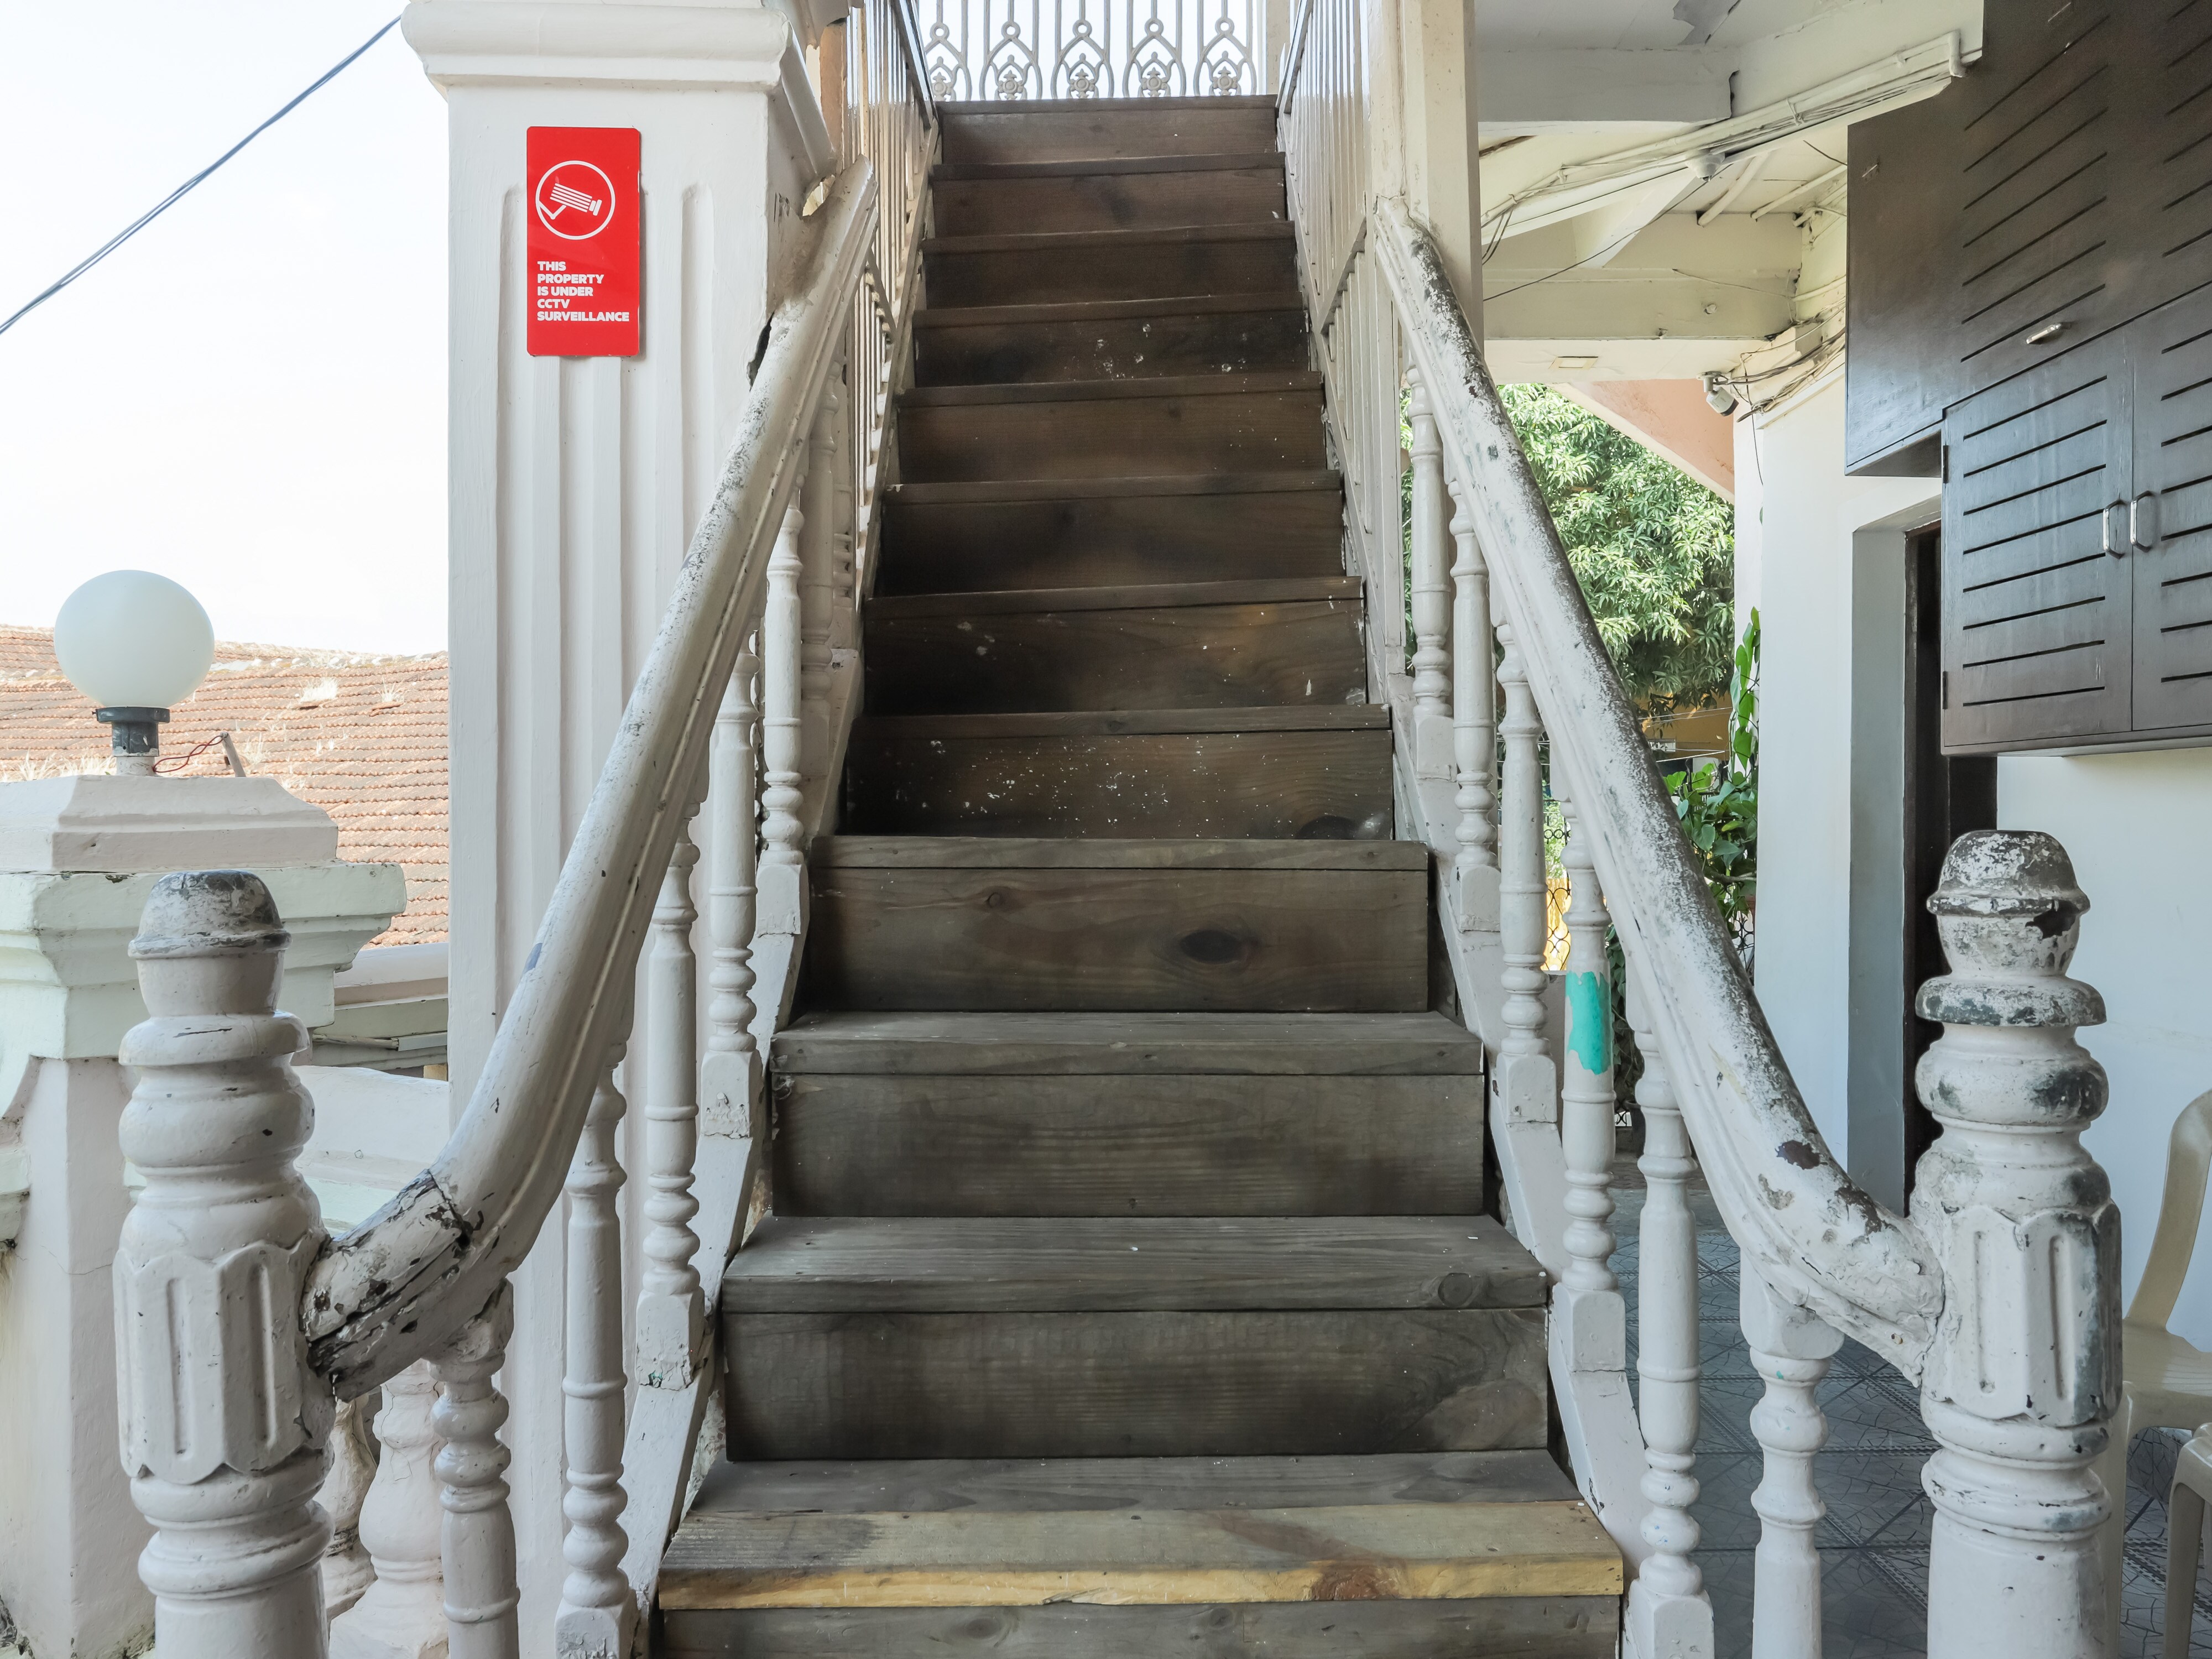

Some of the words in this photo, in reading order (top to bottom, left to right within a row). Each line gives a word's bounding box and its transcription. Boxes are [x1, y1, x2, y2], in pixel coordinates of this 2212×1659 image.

[537, 261, 566, 271] THIS
[537, 274, 604, 284] PROPERTY
[537, 286, 549, 296] IS
[550, 286, 593, 296] UNDER
[537, 299, 570, 309] CCTV
[536, 311, 629, 321] SURVEILLANCE
